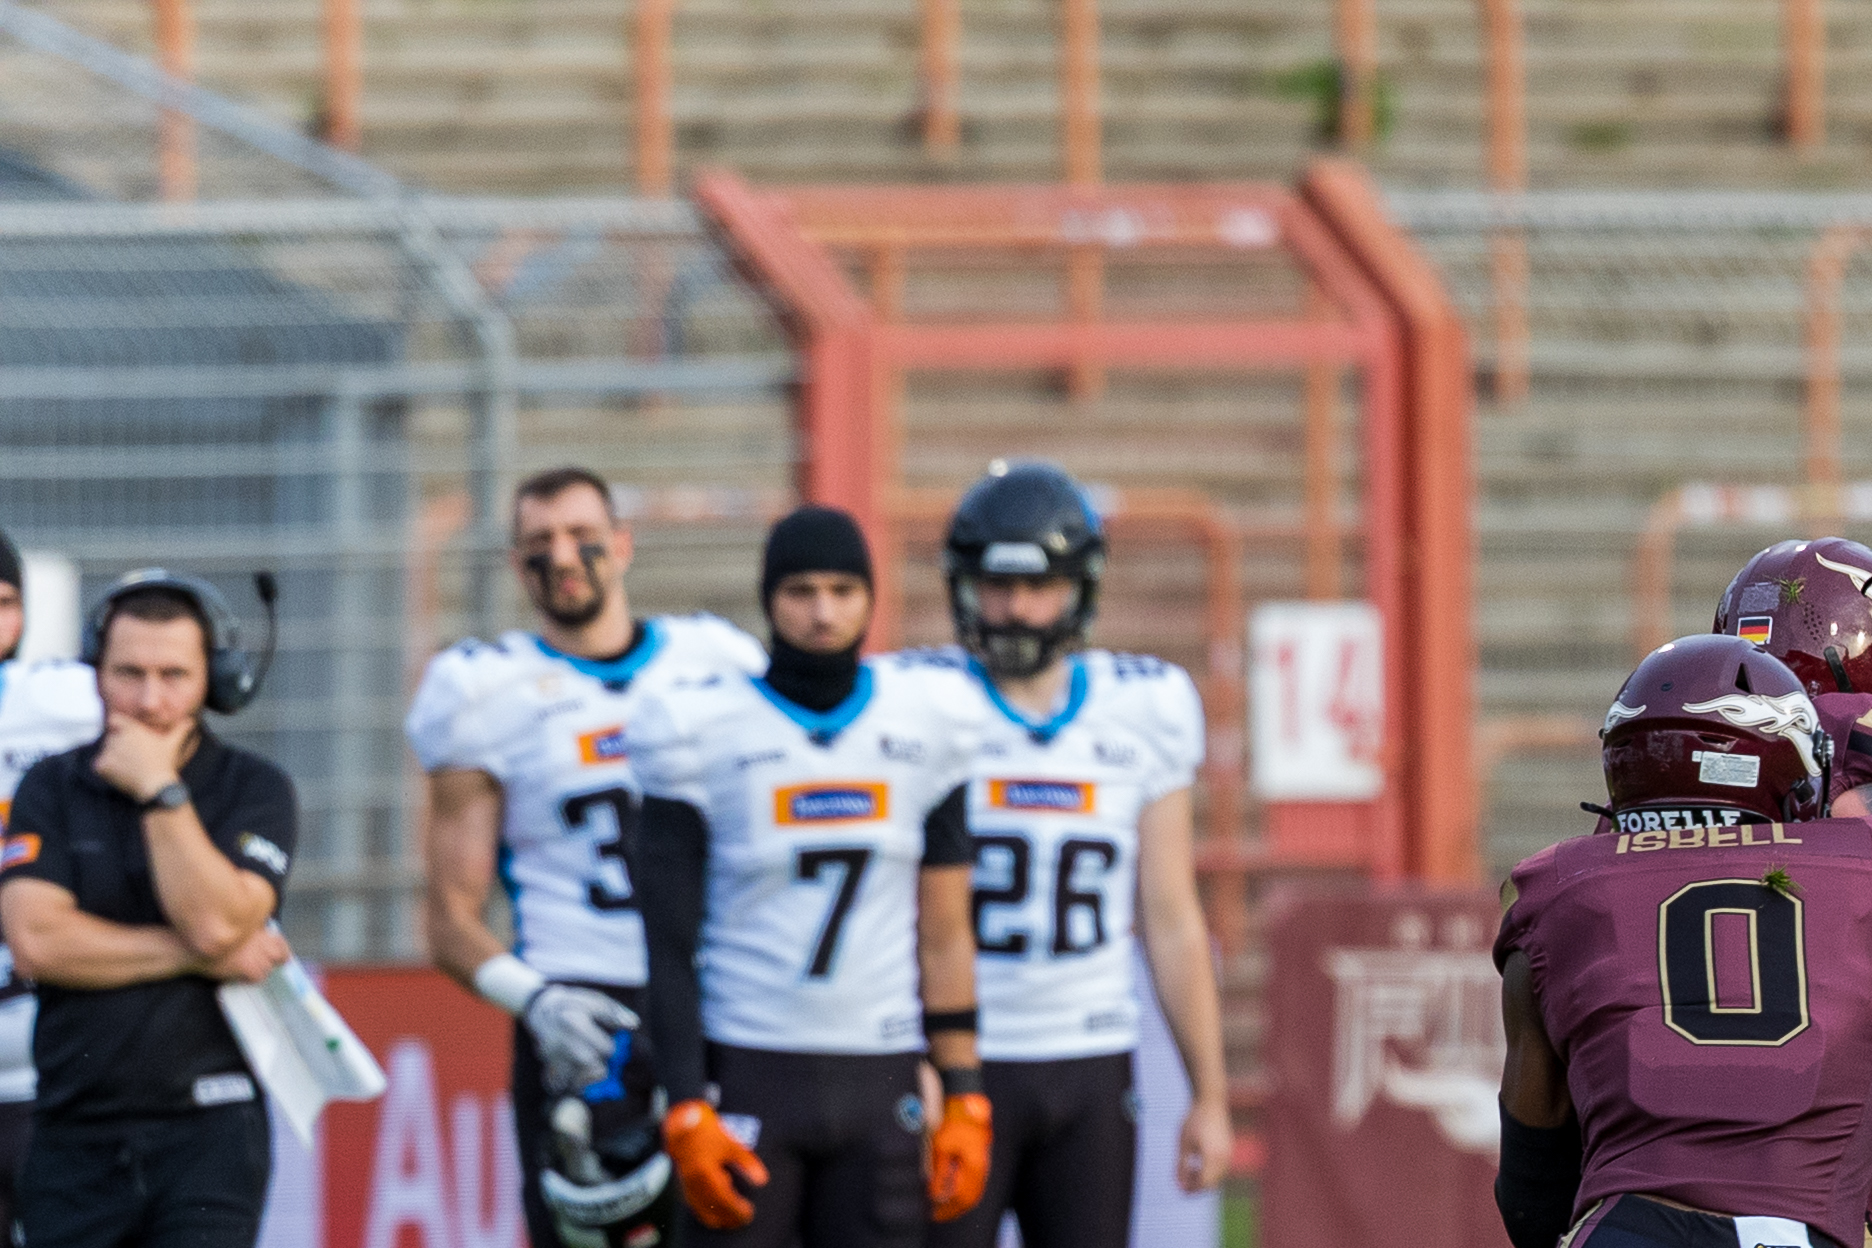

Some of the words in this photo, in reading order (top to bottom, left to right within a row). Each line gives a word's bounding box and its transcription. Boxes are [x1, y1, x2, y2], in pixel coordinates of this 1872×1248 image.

[969, 833, 1118, 956] 26
[1615, 823, 1804, 855] ISBELL
[795, 846, 877, 978] 7
[1656, 876, 1811, 1049] 0
